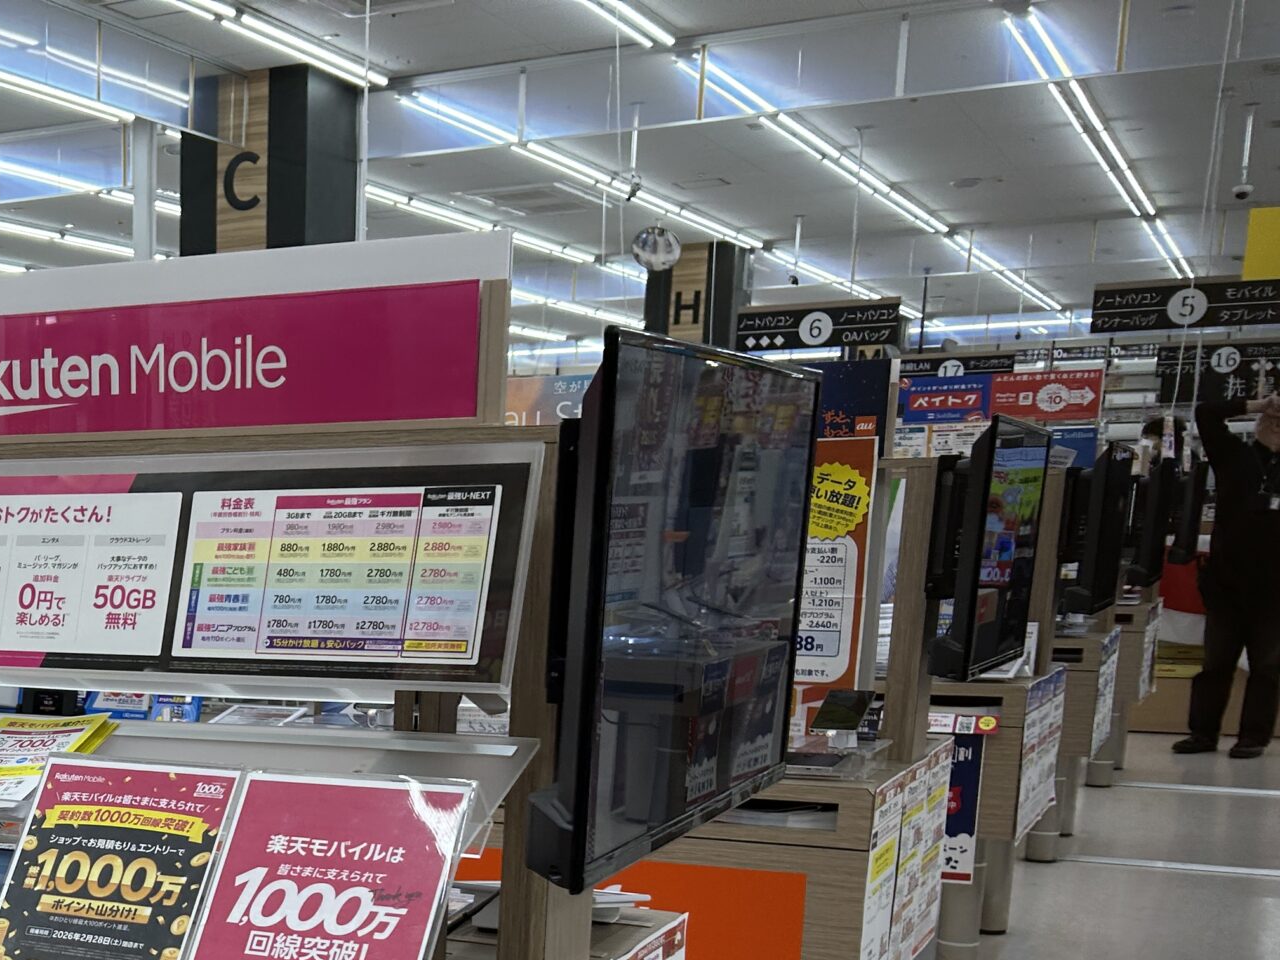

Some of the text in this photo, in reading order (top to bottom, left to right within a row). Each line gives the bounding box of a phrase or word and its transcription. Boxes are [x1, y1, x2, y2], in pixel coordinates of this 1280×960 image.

[223, 151, 261, 211] C
[1095, 292, 1162, 308] ノートパソコン
[1225, 286, 1274, 299] モバイル
[673, 289, 702, 326] H
[1179, 294, 1196, 317] 5
[1219, 307, 1278, 322] タブレット
[739, 315, 795, 330] ノートパソコン
[839, 308, 898, 324] ノートパソコン
[808, 318, 822, 339] 6
[842, 328, 890, 343] OAバッグ
[129, 333, 288, 396] Mobile
[1214, 351, 1238, 369] 16
[942, 363, 962, 378] 17
[913, 393, 978, 408] ペイトク
[855, 420, 876, 431] au
[816, 472, 857, 492] データ
[220, 497, 256, 511] 料金表
[286, 512, 312, 520] 3GBまで
[32, 574, 59, 583] 追加料金
[18, 582, 67, 611] 0円で
[93, 584, 157, 610] 50GB
[15, 612, 66, 628] 楽しめる!
[104, 612, 137, 631] 無料
[9, 739, 57, 748] 7,000
[55, 772, 106, 784] Rakuten Mobile
[61, 791, 206, 814] 楽天モバイルは皆さまに支えられて
[49, 834, 186, 857] ショップでお見積もり&エントリーで
[266, 834, 406, 864] 楽天モバイルは
[277, 863, 388, 885] 皆さまに支えられて
[51, 898, 138, 920] ポイント山分け!
[226, 866, 409, 940] 1,000万
